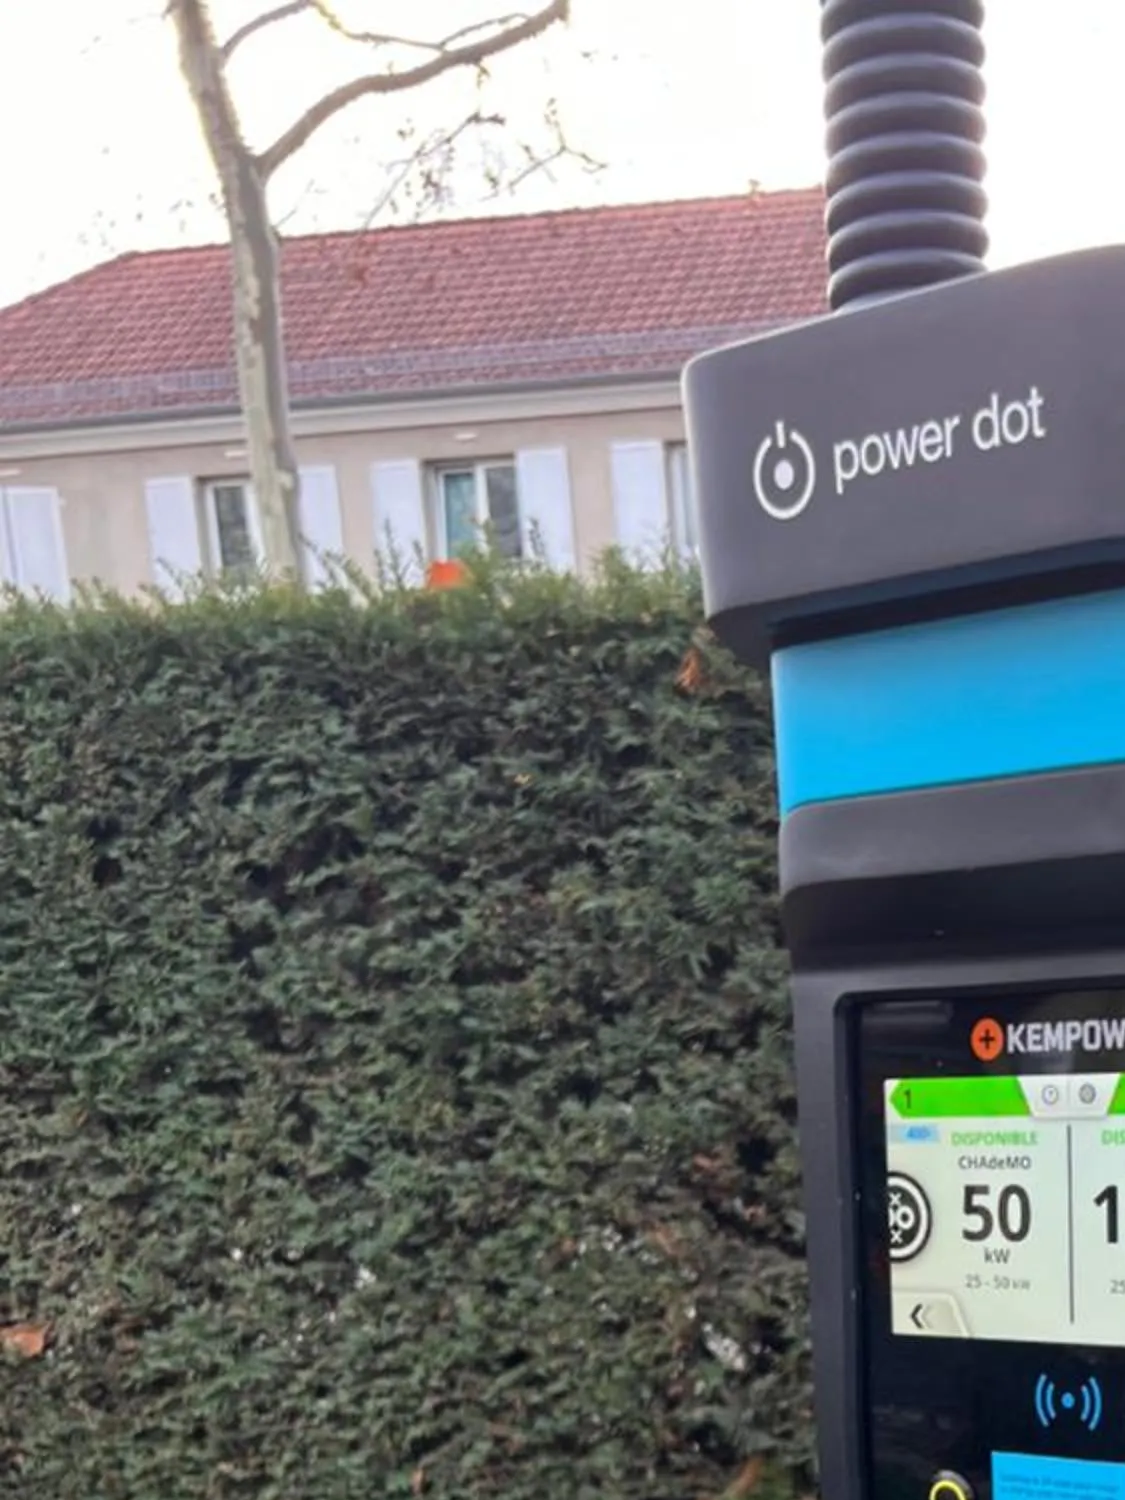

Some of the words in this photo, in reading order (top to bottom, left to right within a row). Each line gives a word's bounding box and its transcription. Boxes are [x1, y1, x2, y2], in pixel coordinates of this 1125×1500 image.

[833, 414, 961, 493] power
[971, 386, 1046, 449] dot
[903, 1088, 911, 1109] 1
[951, 1129, 1038, 1147] DISPONIBLE
[957, 1154, 1032, 1170] CHAdeMO
[961, 1183, 1032, 1243] 50
[983, 1247, 1011, 1264] kW
[965, 1274, 982, 1289] 25
